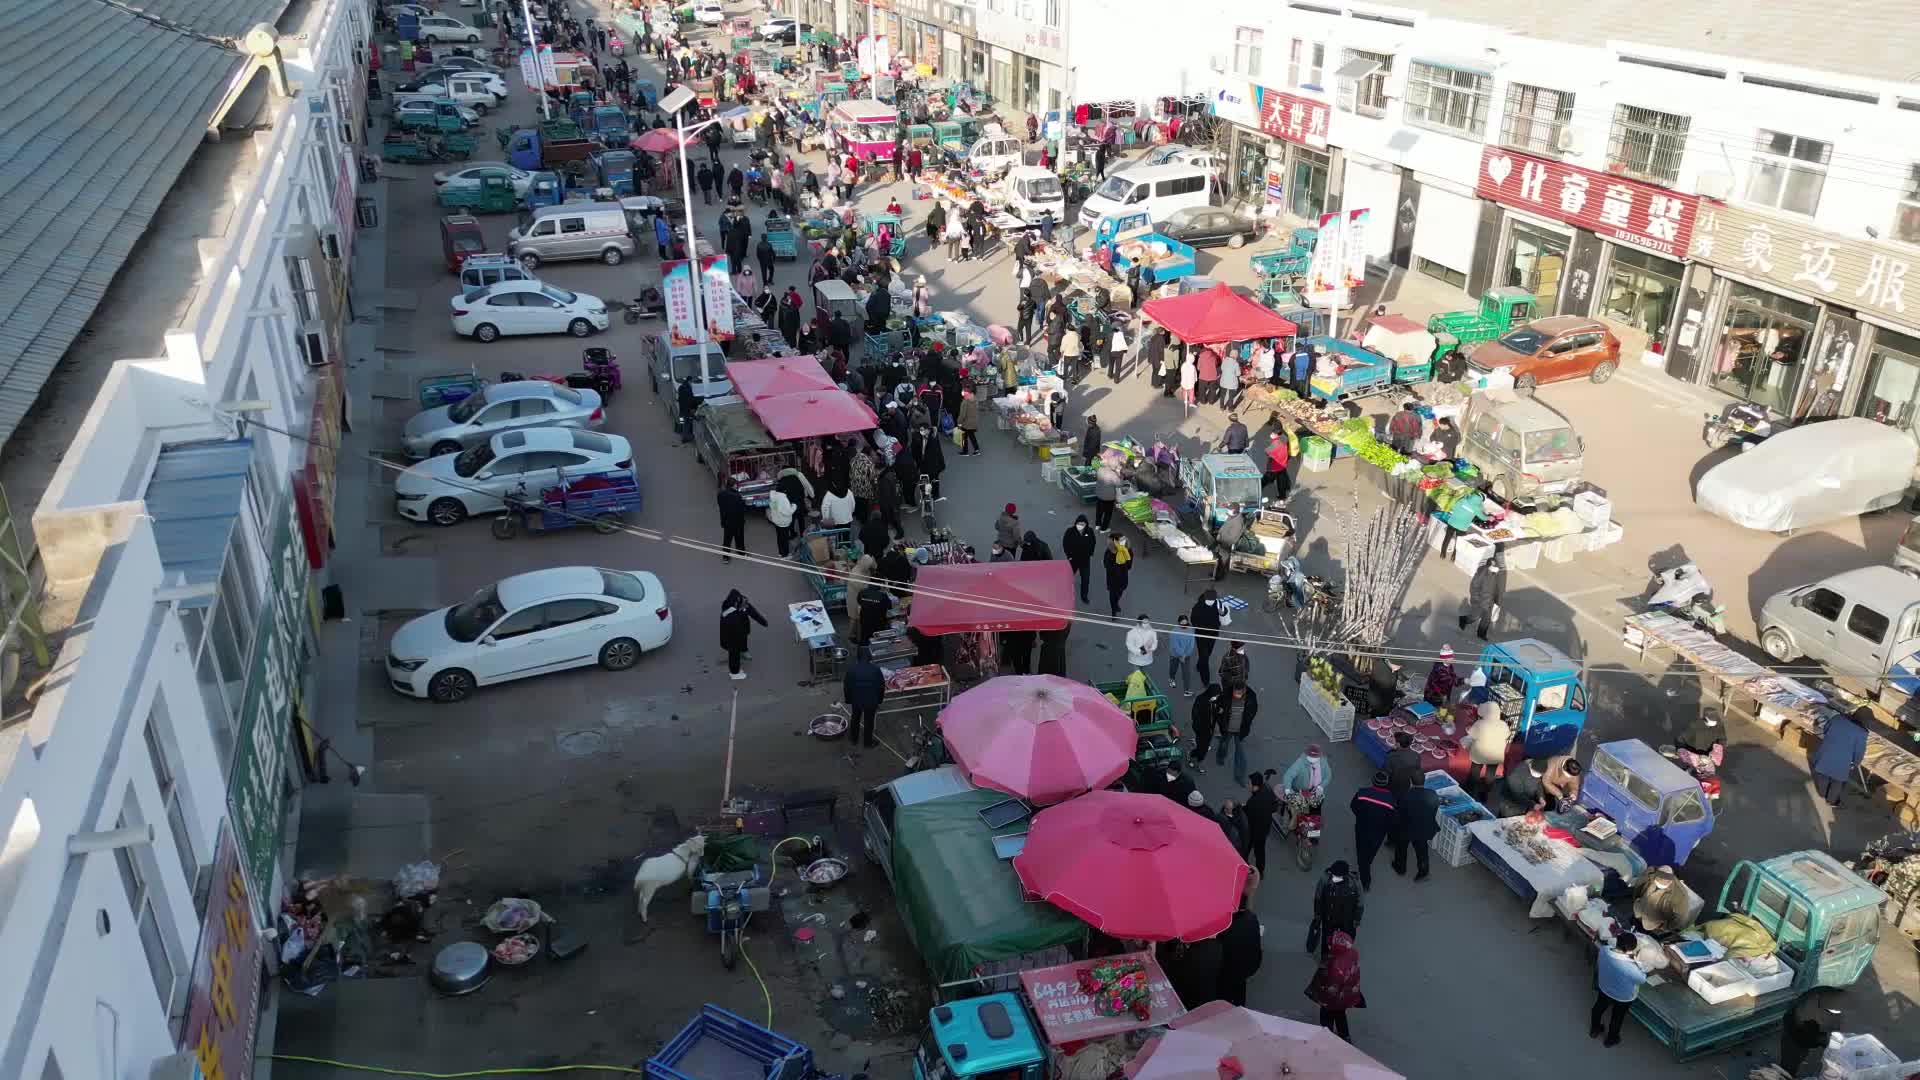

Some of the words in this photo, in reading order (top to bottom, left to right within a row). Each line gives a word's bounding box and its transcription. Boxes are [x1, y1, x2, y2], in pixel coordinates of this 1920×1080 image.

[1268, 97, 1325, 135] 大世界
[1615, 230, 1673, 254] 18315963715
[1736, 224, 1909, 313] 豪迈服
